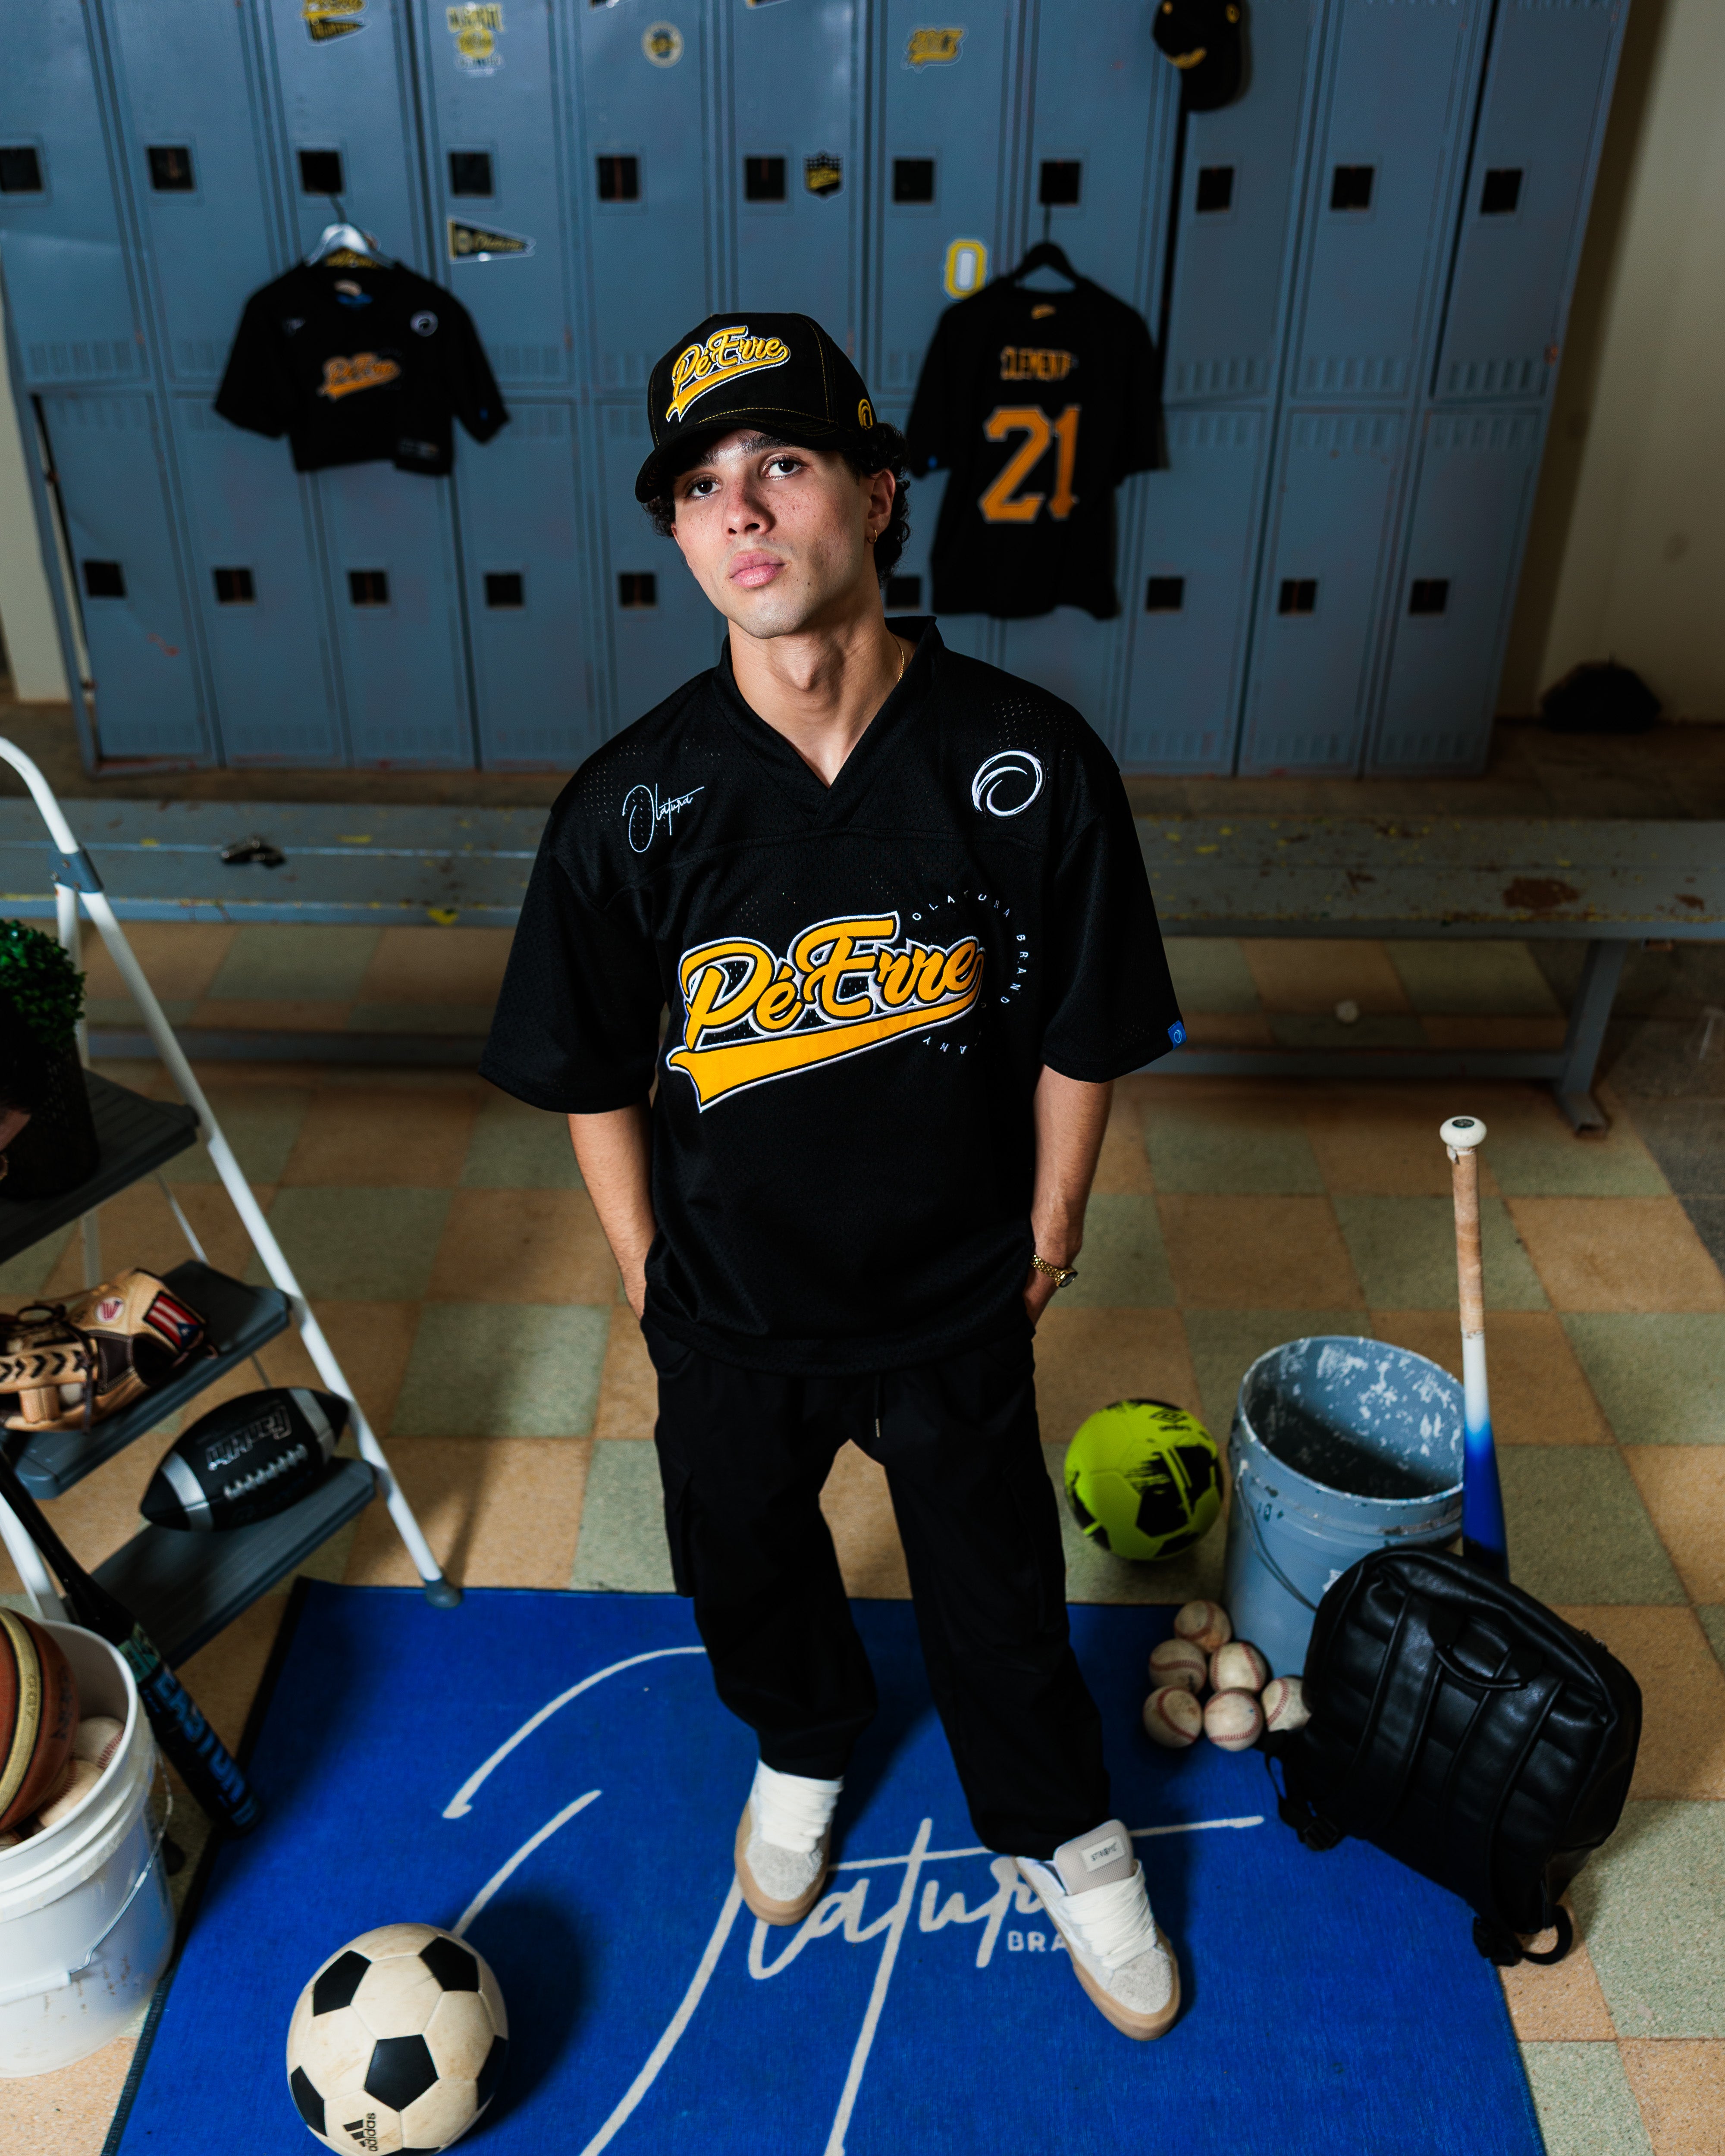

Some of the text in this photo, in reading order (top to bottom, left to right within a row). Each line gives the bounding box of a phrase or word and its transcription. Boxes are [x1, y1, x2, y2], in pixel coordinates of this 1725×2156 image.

[979, 403, 1082, 523] 21
[912, 890, 1010, 921] OLATURA
[1000, 934, 1029, 1003] BRAND
[364, 2113, 378, 2152] adidas
